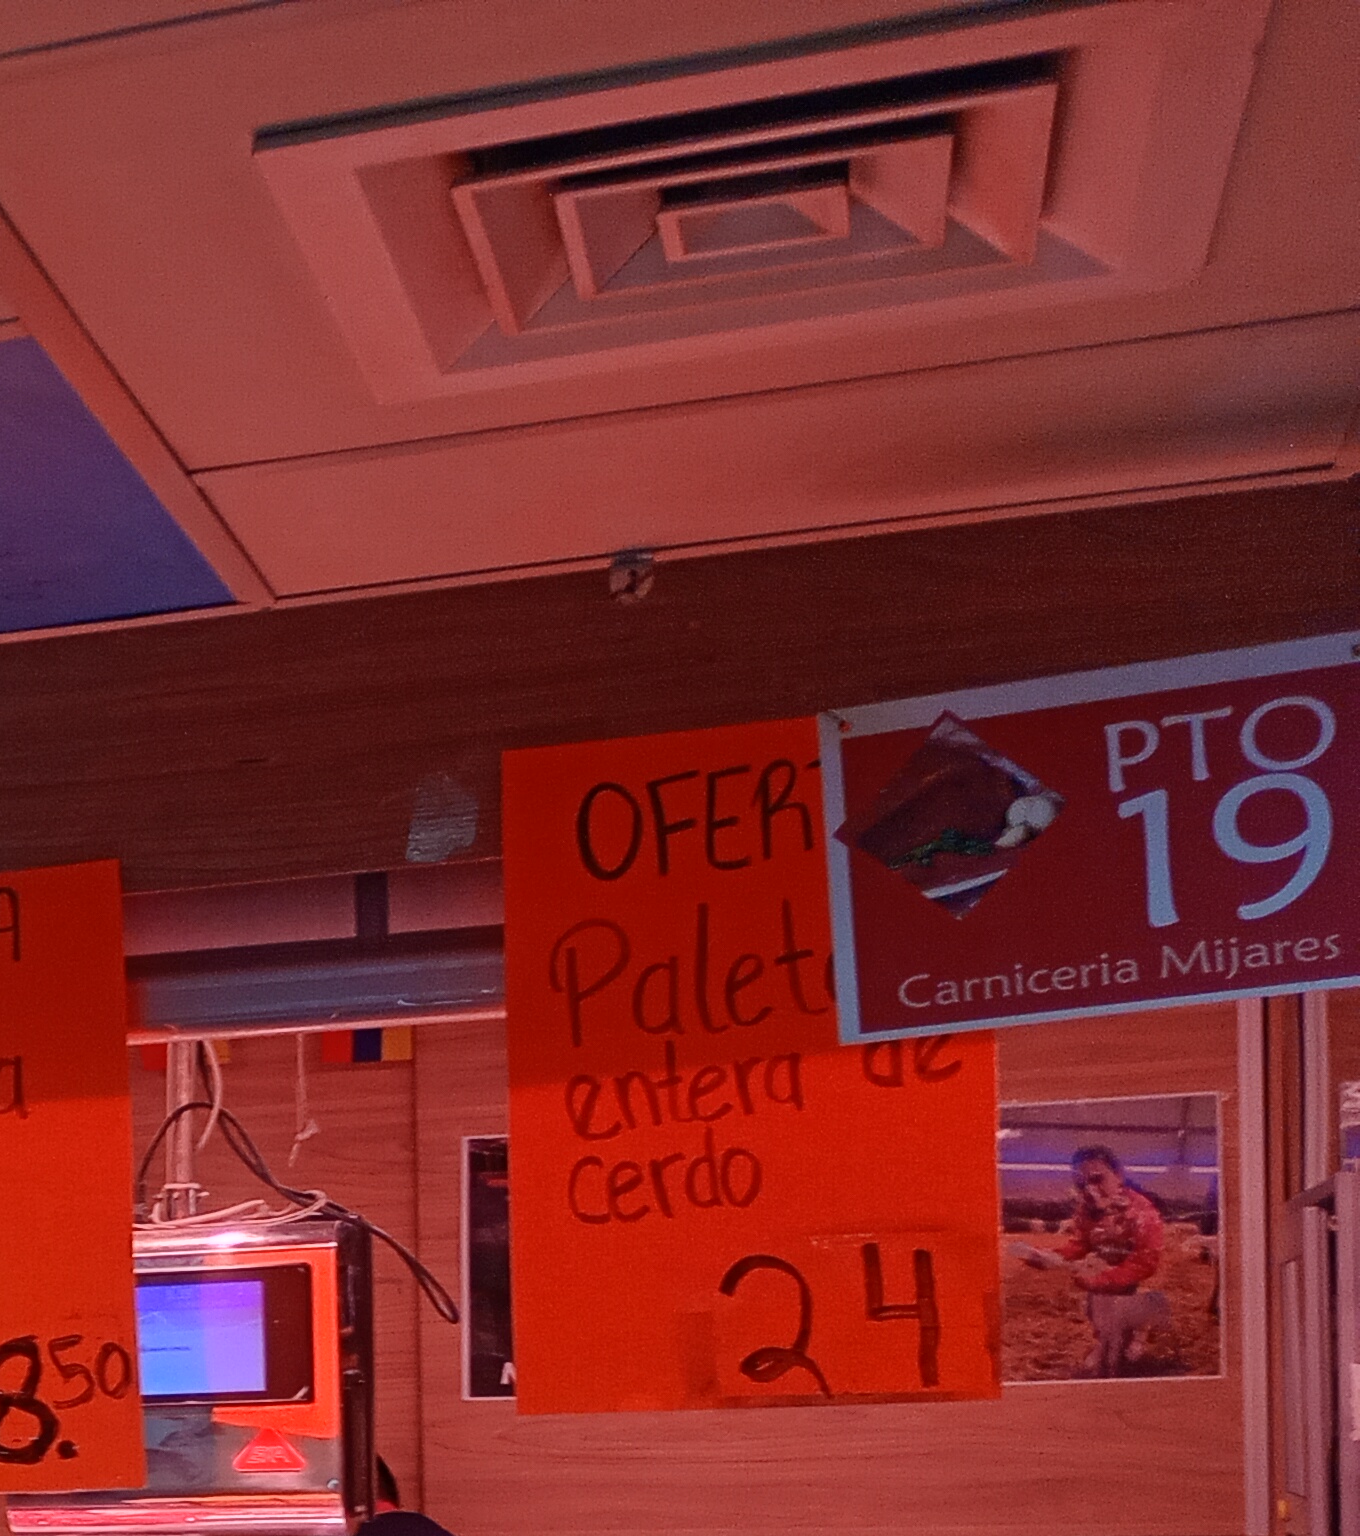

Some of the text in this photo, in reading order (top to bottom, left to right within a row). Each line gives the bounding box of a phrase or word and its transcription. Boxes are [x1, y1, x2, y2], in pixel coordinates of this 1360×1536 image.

[1104, 695, 1338, 795] PTO
[576, 757, 821, 882] OFER
[1118, 771, 1336, 930] 19
[897, 929, 1342, 1010] Carniceria Mijares
[565, 1040, 806, 1143] entera
[717, 1240, 941, 1398] 24
